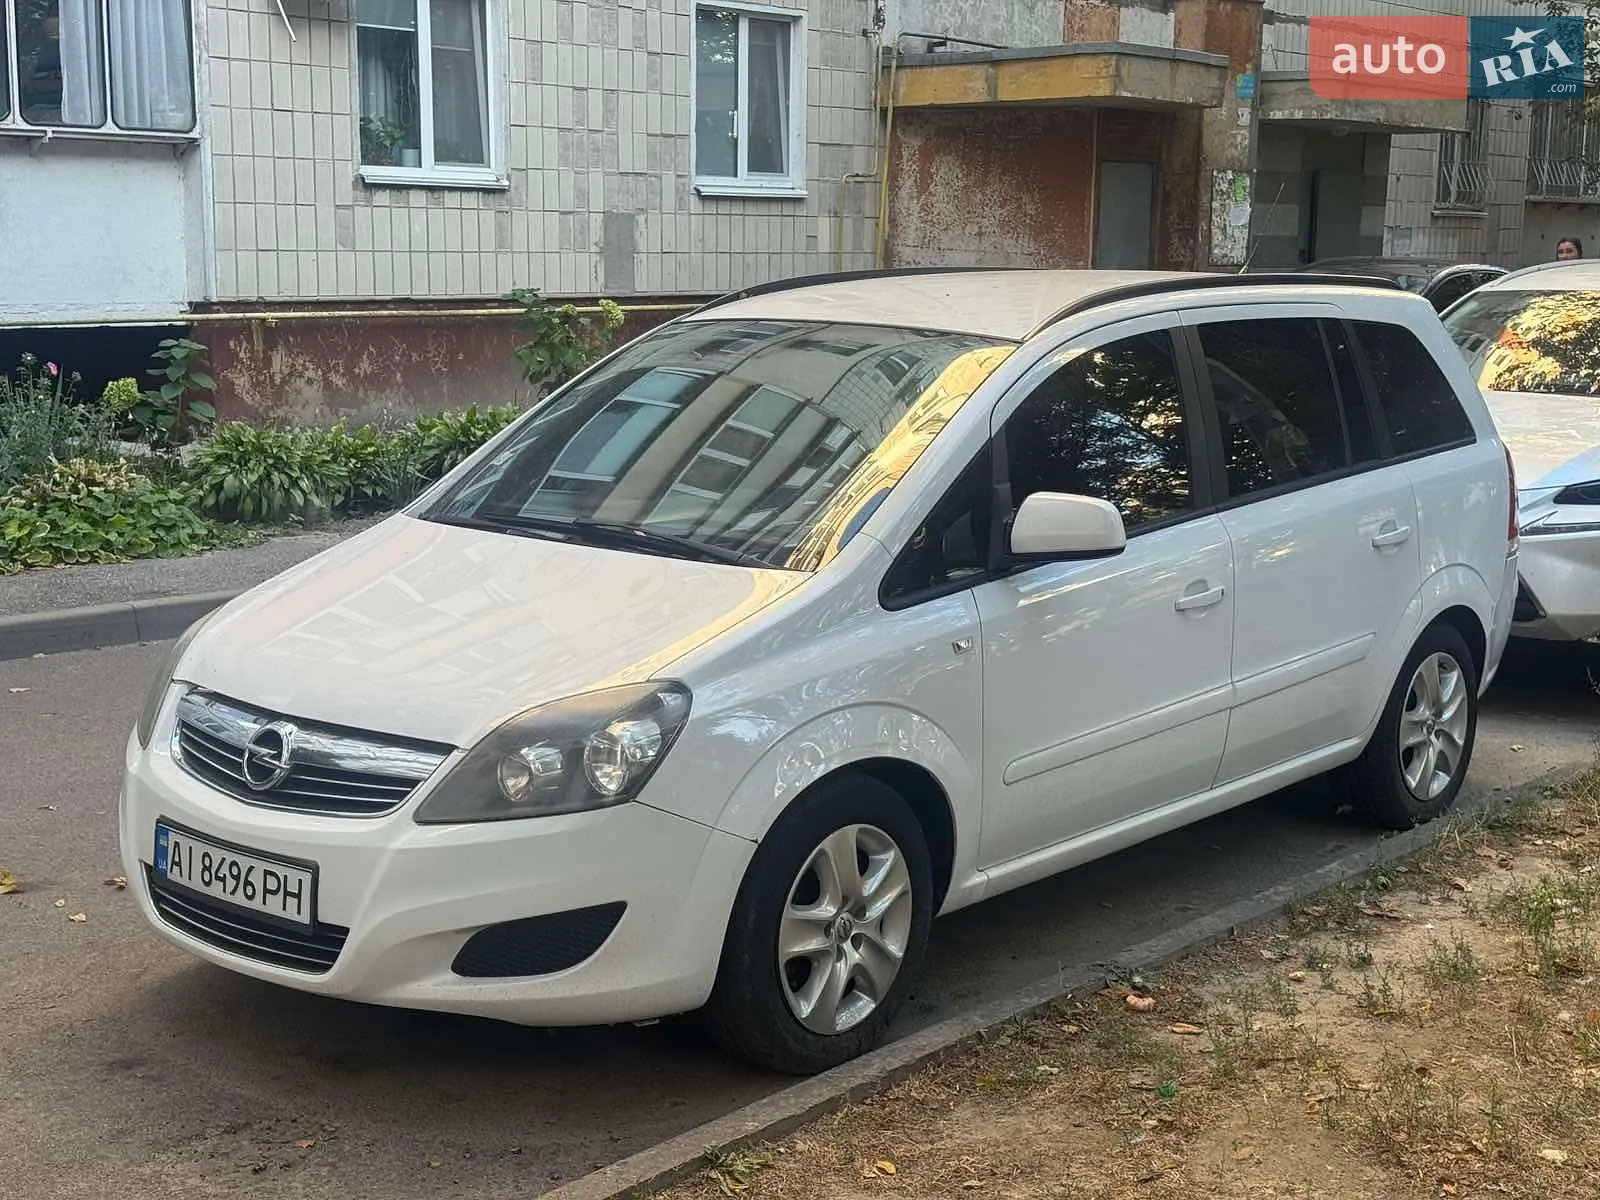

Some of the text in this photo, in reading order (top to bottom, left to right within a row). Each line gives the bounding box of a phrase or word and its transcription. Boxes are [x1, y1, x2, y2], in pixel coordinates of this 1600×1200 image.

[158, 858, 168, 870] UA
[200, 851, 257, 901] 8496
[262, 868, 303, 916] PH
